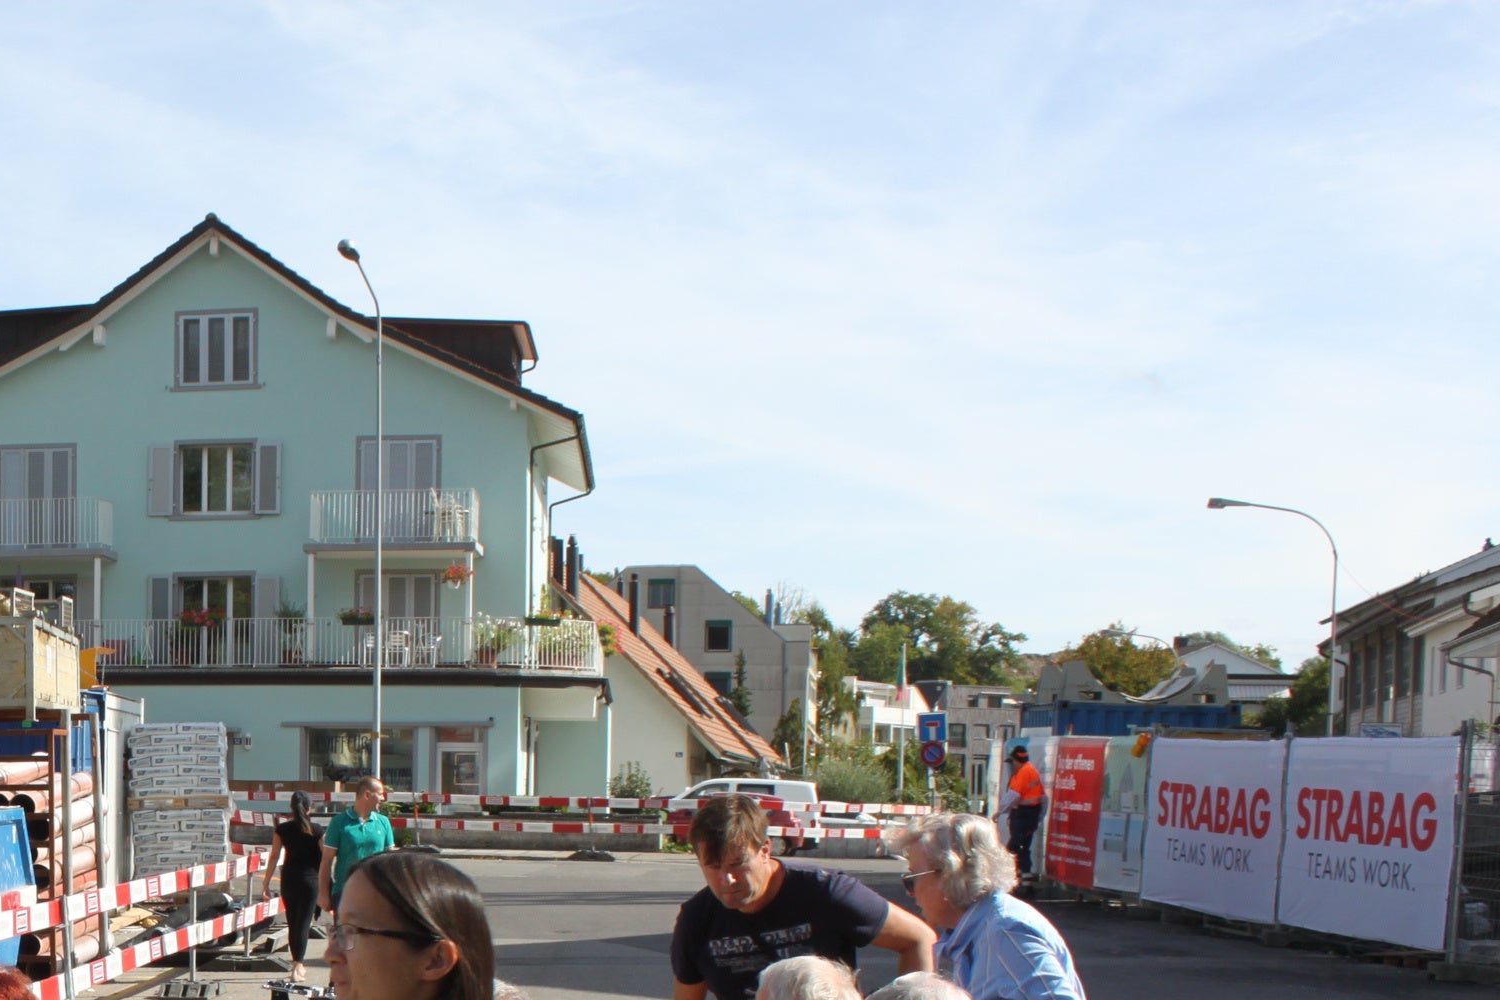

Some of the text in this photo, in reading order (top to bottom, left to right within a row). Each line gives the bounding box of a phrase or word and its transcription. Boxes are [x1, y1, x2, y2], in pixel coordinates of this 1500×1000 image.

[1157, 780, 1271, 839] STRABAG
[1296, 787, 1437, 852] STRABAG
[1167, 838, 1206, 866] TEAMS
[1308, 852, 1415, 891] TEAMS WORK.
